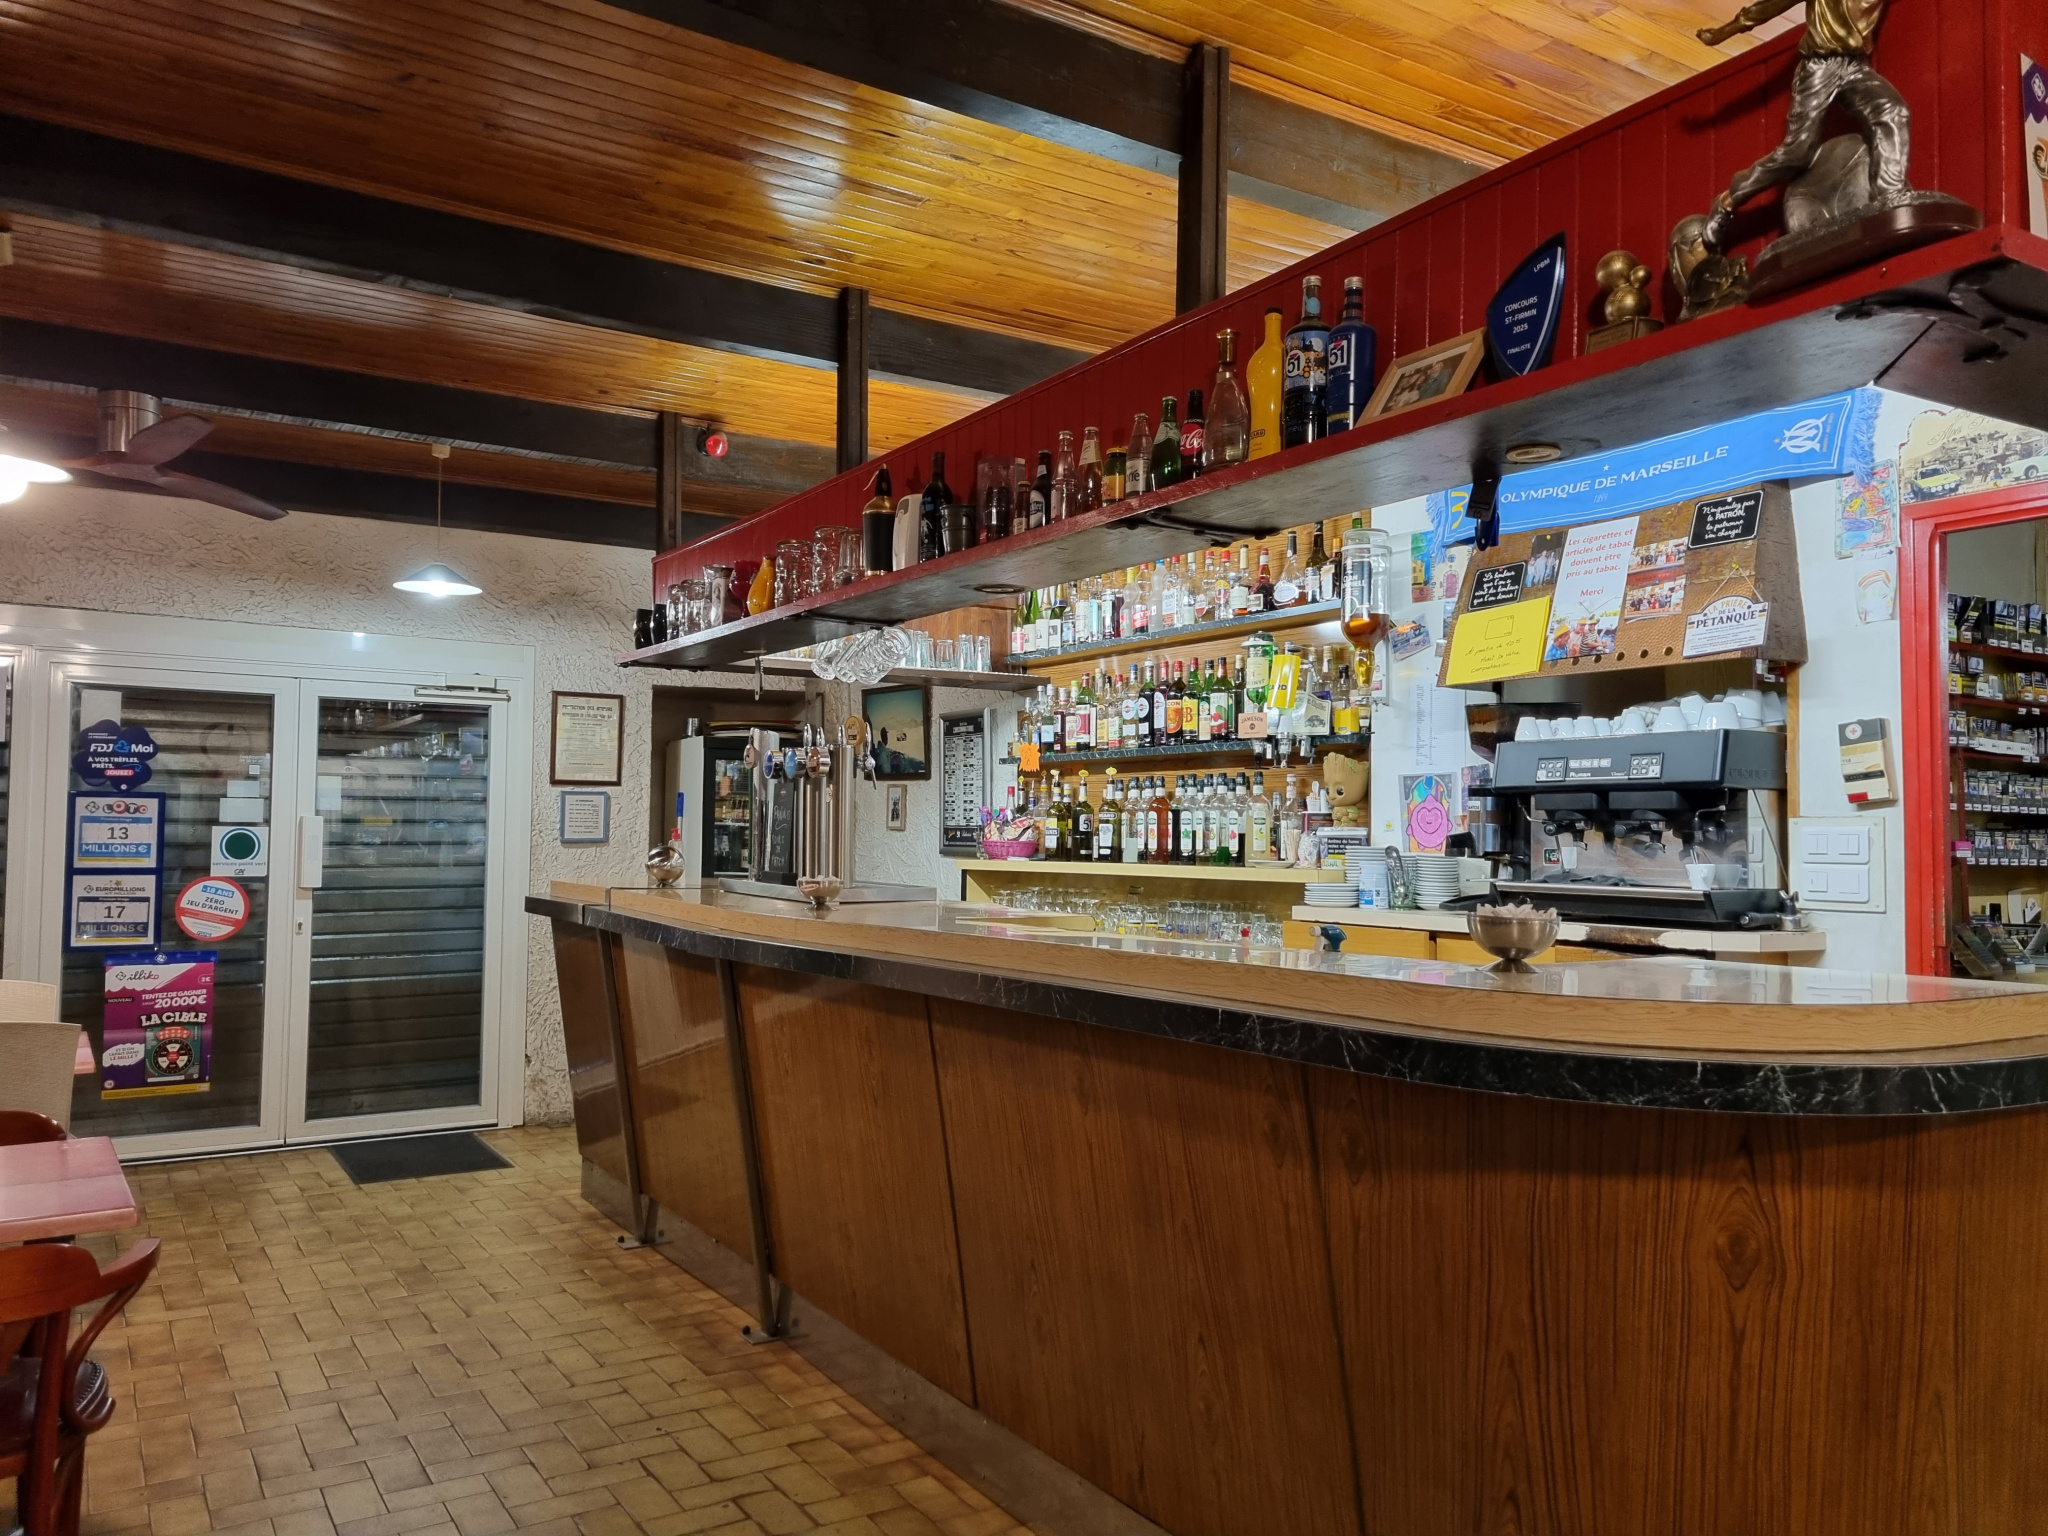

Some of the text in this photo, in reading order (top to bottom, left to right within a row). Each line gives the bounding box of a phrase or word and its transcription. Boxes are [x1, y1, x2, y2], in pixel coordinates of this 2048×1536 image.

[1504, 296, 1538, 313] CONCOURS
[1504, 308, 1537, 325] ST-FIRMIN
[1512, 323, 1529, 334] 2025
[1506, 343, 1531, 355] FINALISTE
[1329, 347, 1345, 366] 51
[1287, 355, 1301, 374] 51
[1500, 445, 1729, 504] OLYMPIQUE DE MARSEILLE
[1714, 519, 1744, 532] patronne
[1582, 531, 1622, 544] cigarettes
[1624, 528, 1633, 536] et
[1565, 540, 1632, 557] articles de tabac
[1570, 553, 1622, 567] doivent être
[1566, 569, 1581, 580] pris
[1596, 564, 1621, 574] tabac.
[1580, 587, 1605, 597] Merci
[1708, 605, 1718, 615] LA
[1696, 609, 1757, 629] PÉTANQUE
[1241, 716, 1264, 724] JAMESON
[90, 743, 114, 753] FDJ
[131, 743, 154, 753] Moi
[107, 826, 129, 840] 13
[82, 844, 148, 853] MILLIONS €
[216, 889, 233, 898] ANS
[186, 899, 240, 916] JEU D'ARGENT
[204, 896, 225, 906] ZÉRO
[103, 906, 126, 919] 17
[80, 924, 145, 932] MILLIONS €
[127, 970, 160, 981] illiko
[142, 992, 165, 1000] TENTEZ
[140, 1011, 208, 1026] LA CIBLE
